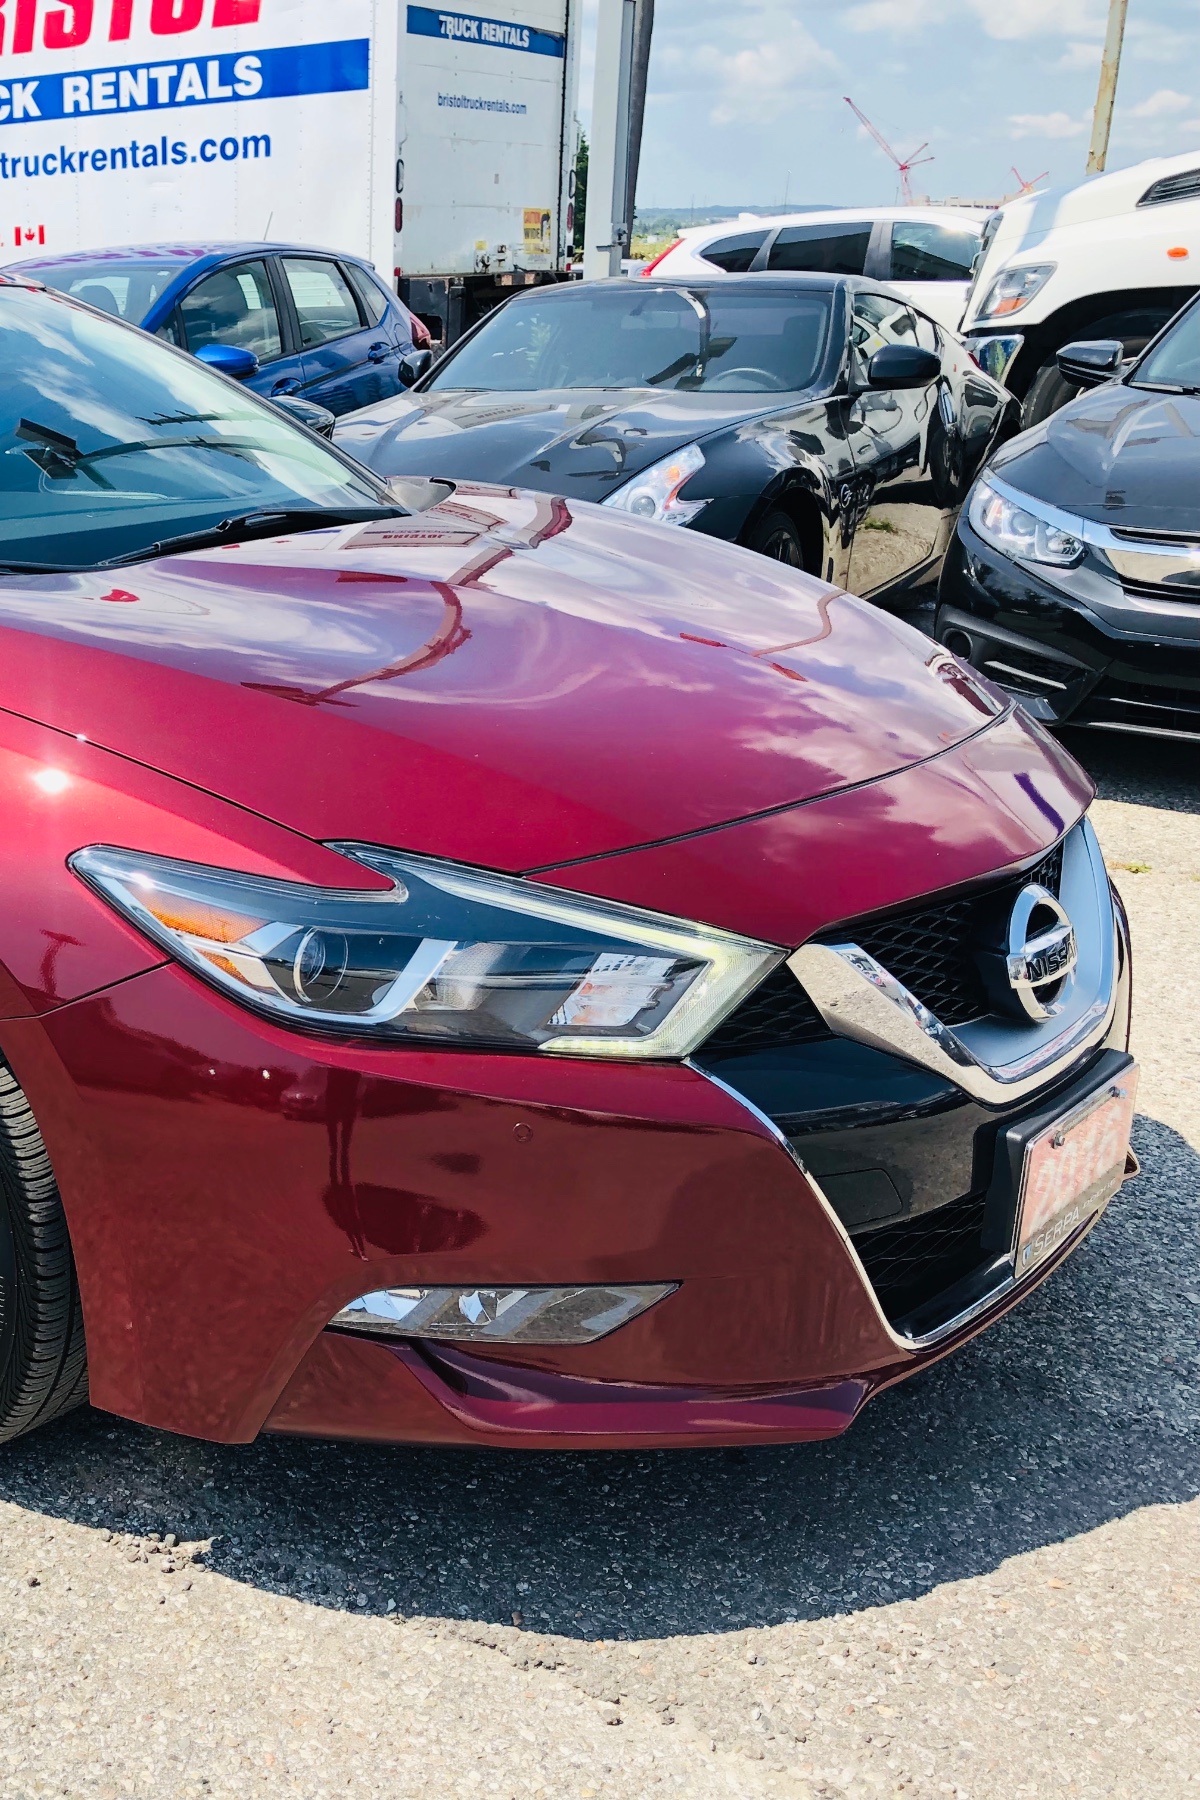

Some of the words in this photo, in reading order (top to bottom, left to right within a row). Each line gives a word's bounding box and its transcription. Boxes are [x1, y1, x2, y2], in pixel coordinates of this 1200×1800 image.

[438, 14, 479, 40] TRUCK
[481, 21, 530, 48] RENTALS
[62, 55, 263, 114] RENTALS
[437, 92, 527, 115] bristoltruckrentals.com
[1033, 1206, 1079, 1256] SERPA
